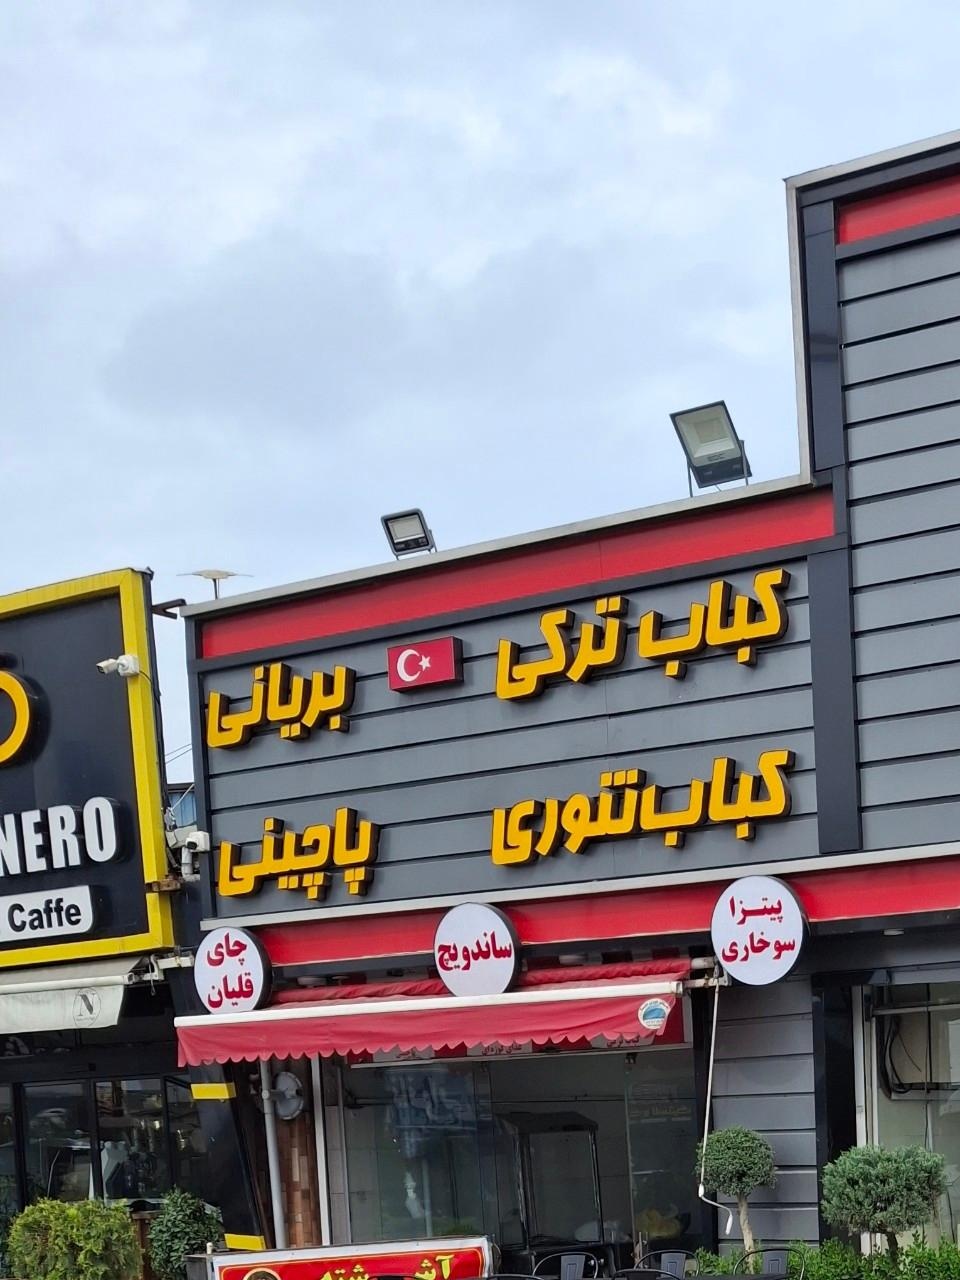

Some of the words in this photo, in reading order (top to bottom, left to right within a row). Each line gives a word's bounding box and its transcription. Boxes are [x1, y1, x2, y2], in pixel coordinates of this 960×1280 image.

[496, 595, 627, 699] ترکی
[637, 568, 789, 678] کباب
[207, 661, 353, 748] بریانی
[0, 797, 116, 876] NERO
[491, 768, 645, 865] تنوری
[640, 749, 794, 847] کباب
[218, 806, 377, 900] پاچینی
[8, 898, 82, 932] Caffe
[206, 932, 247, 967] چای
[721, 931, 796, 963] سوخاری
[729, 896, 783, 925] پیتزا
[207, 972, 255, 1008] قلیان
[437, 931, 513, 971] ساندویچ
